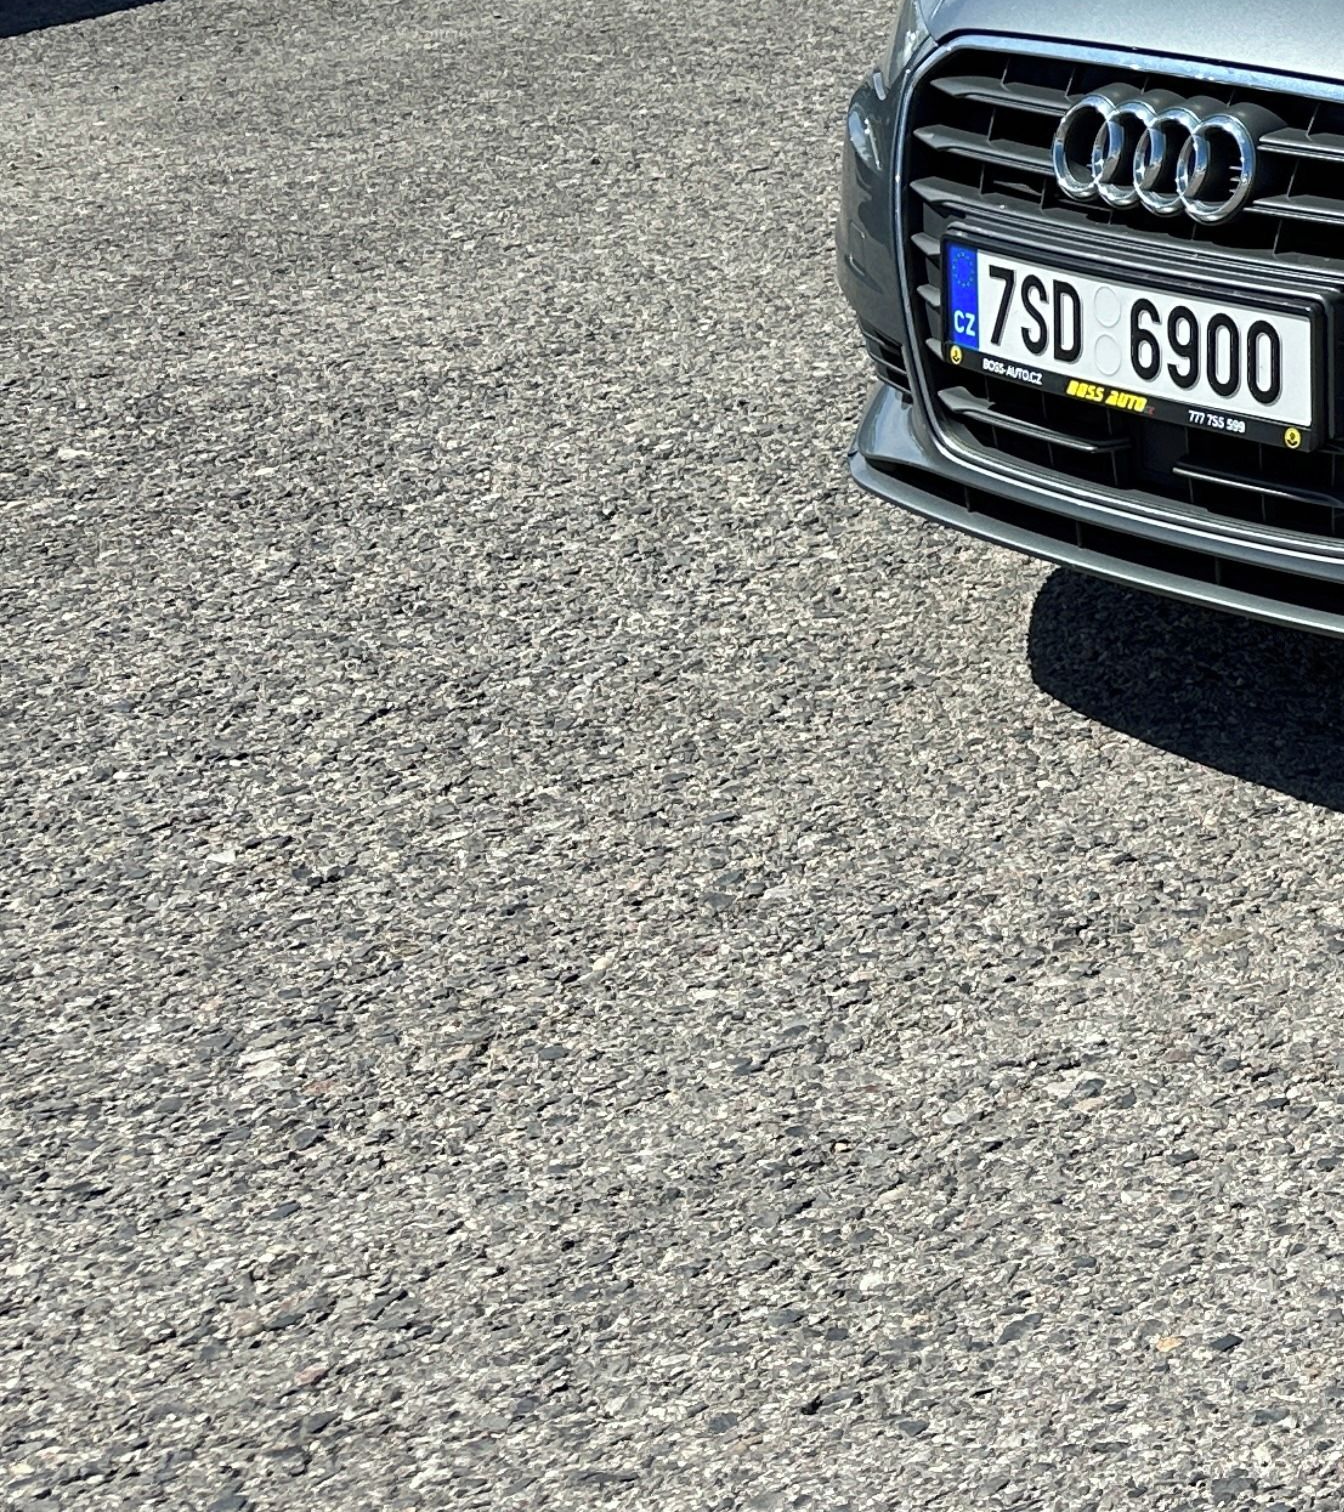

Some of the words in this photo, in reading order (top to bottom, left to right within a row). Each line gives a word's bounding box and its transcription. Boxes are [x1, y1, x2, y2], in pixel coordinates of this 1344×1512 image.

[954, 309, 976, 337] CZ
[989, 264, 1082, 363] 7SD
[1130, 298, 1281, 405] 6900
[1066, 379, 1104, 403] BOSS
[1105, 389, 1148, 413] AUTO
[1188, 409, 1204, 424] 777
